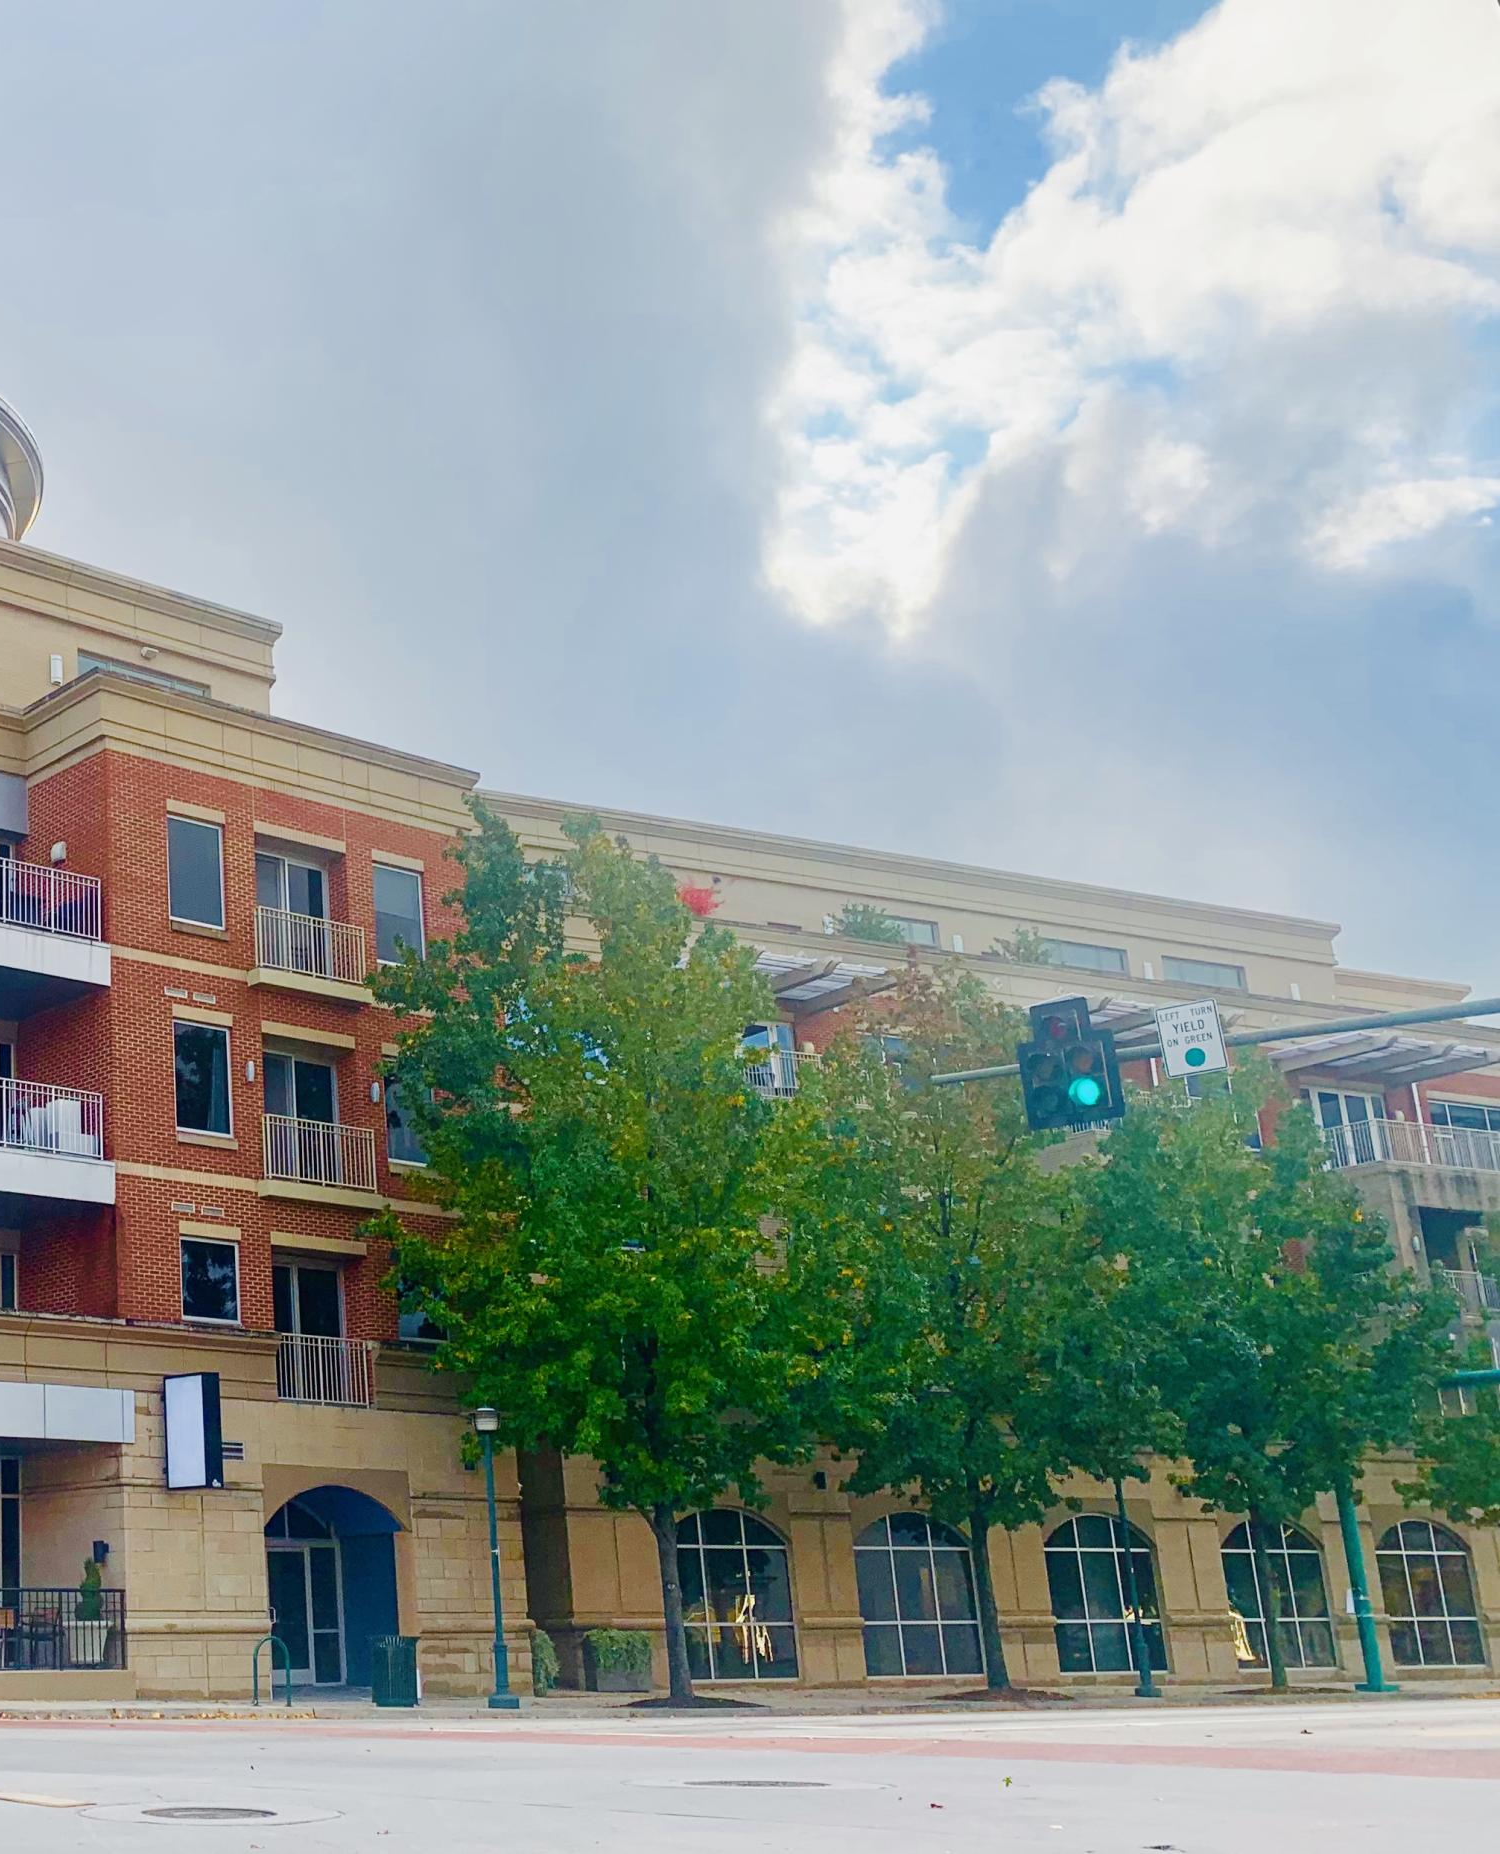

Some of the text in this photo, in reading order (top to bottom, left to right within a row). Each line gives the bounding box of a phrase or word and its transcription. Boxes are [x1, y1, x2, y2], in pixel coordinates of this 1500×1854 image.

[1160, 1006, 1213, 1022] LEFT TURN
[1172, 1019, 1205, 1034] YIELD
[1167, 1032, 1213, 1048] ON GREEN
